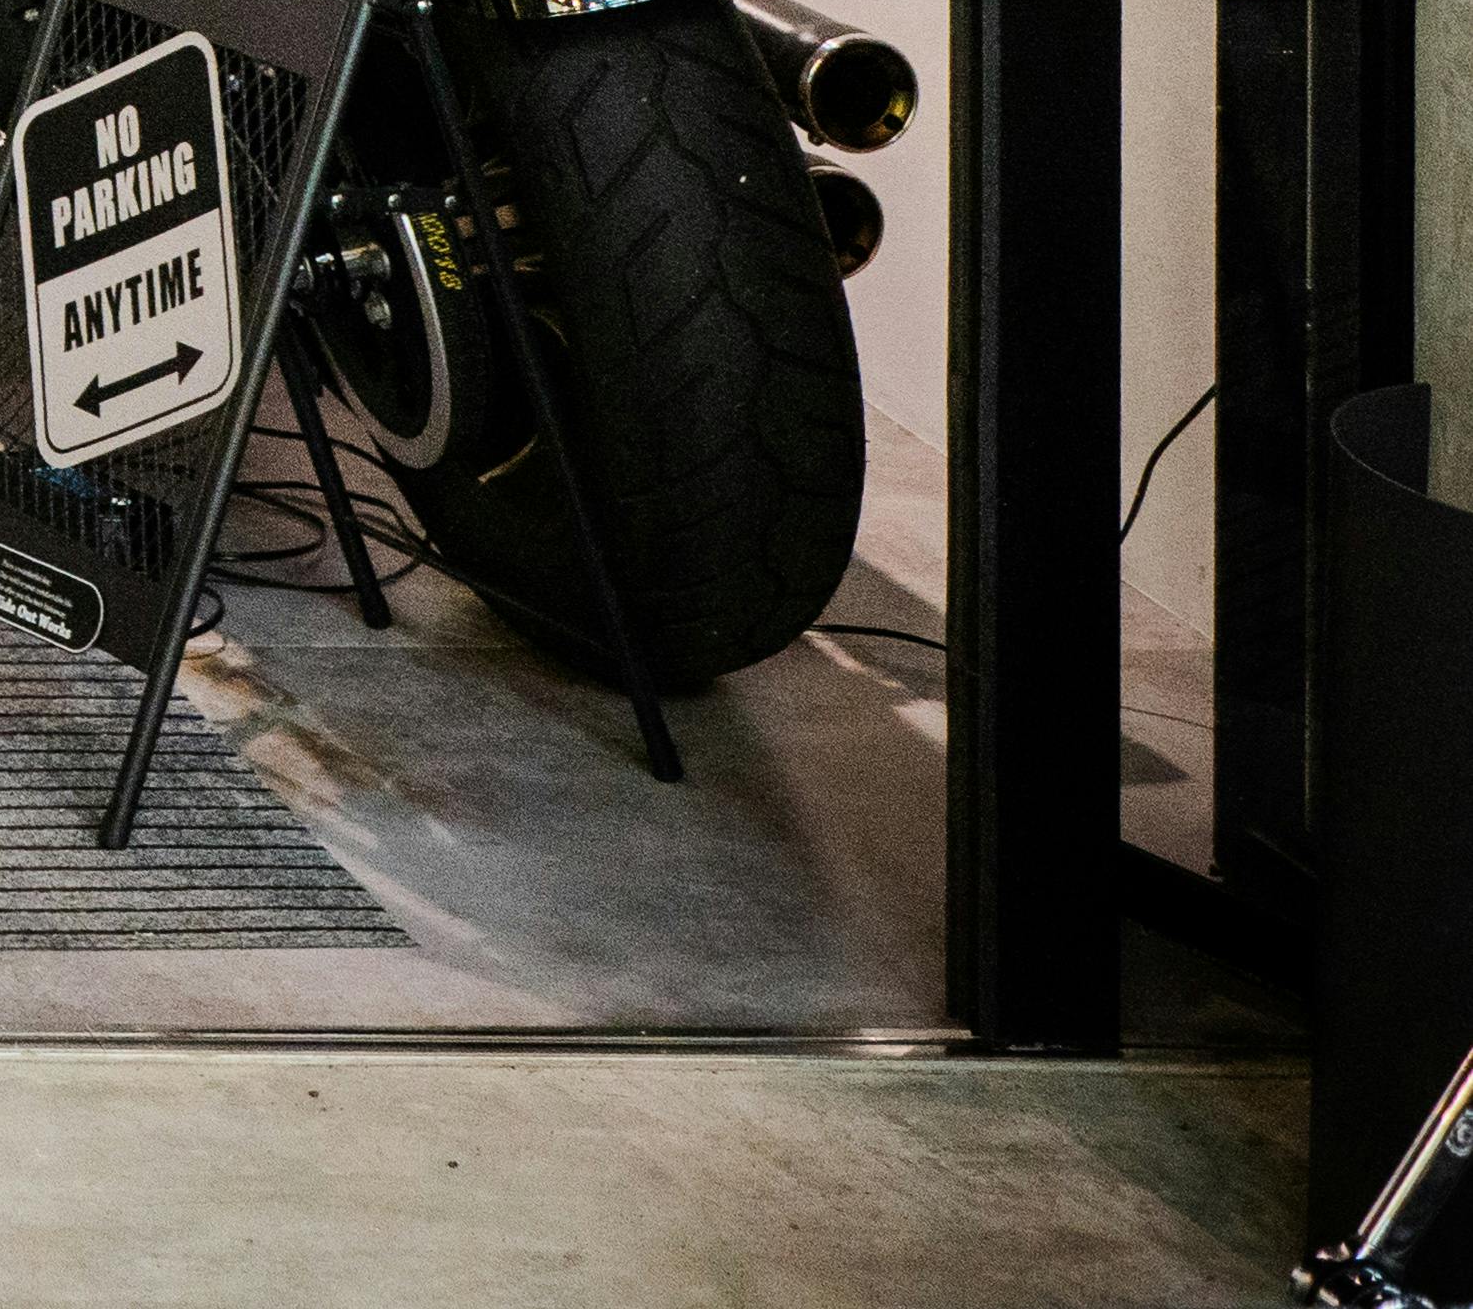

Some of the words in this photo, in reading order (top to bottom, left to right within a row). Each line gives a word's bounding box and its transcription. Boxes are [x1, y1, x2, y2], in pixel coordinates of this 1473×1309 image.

[94, 102, 141, 171] NO
[50, 141, 198, 249] PARKING
[63, 248, 206, 354] ANYTIME
[17, 605, 38, 625] Out
[38, 613, 72, 640] Works
